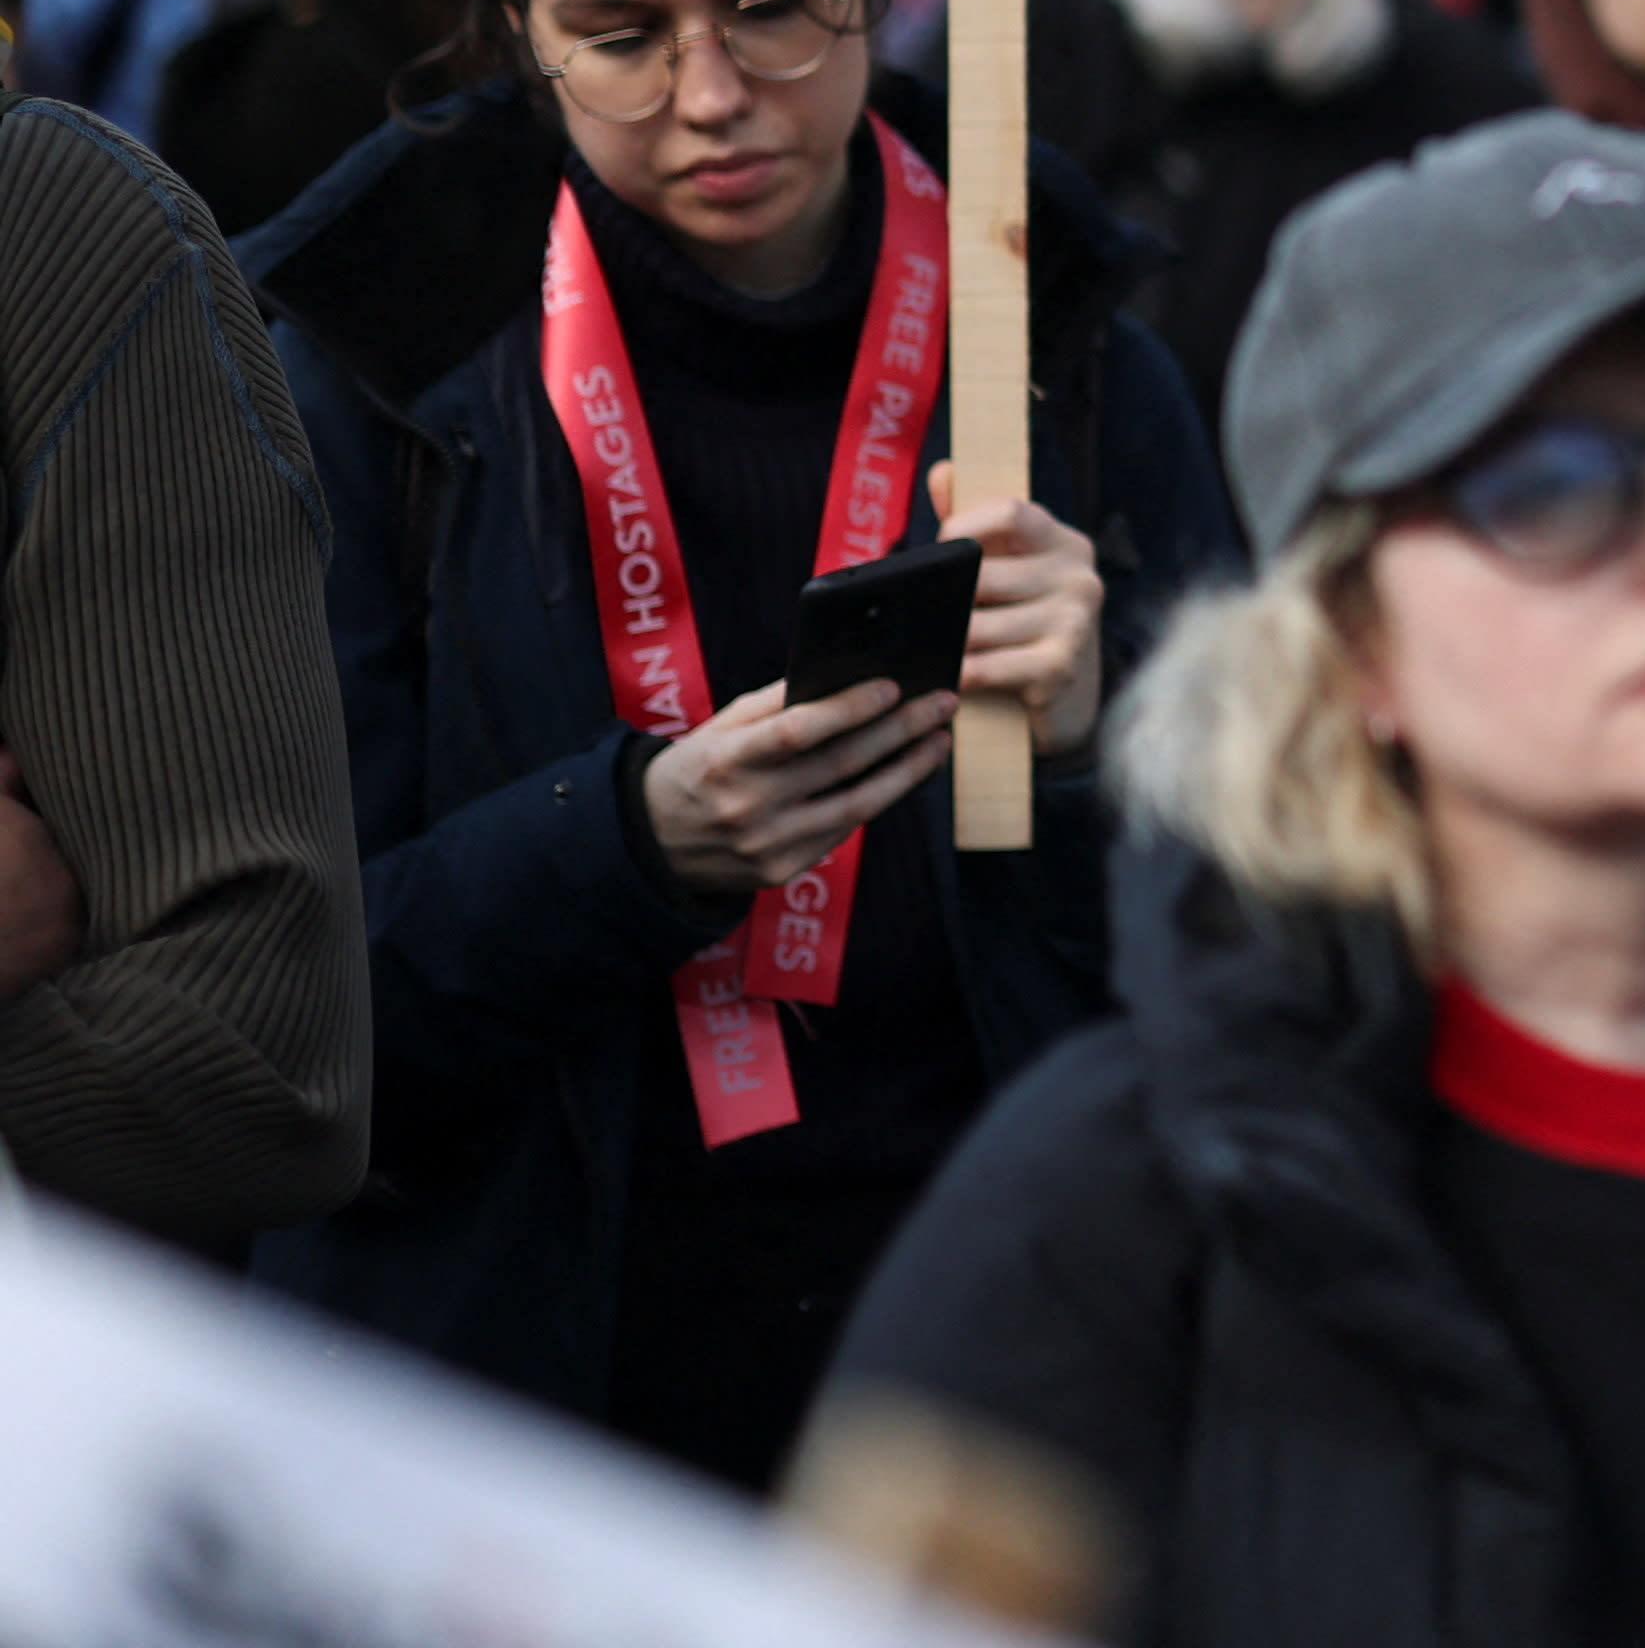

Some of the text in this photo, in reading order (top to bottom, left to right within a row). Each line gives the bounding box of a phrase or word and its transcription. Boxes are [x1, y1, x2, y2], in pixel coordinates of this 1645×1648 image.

[881, 253, 940, 376] FREE
[574, 364, 668, 636] HOSTAGES
[839, 380, 914, 568] PALEST
[701, 973, 763, 1095] FREE
